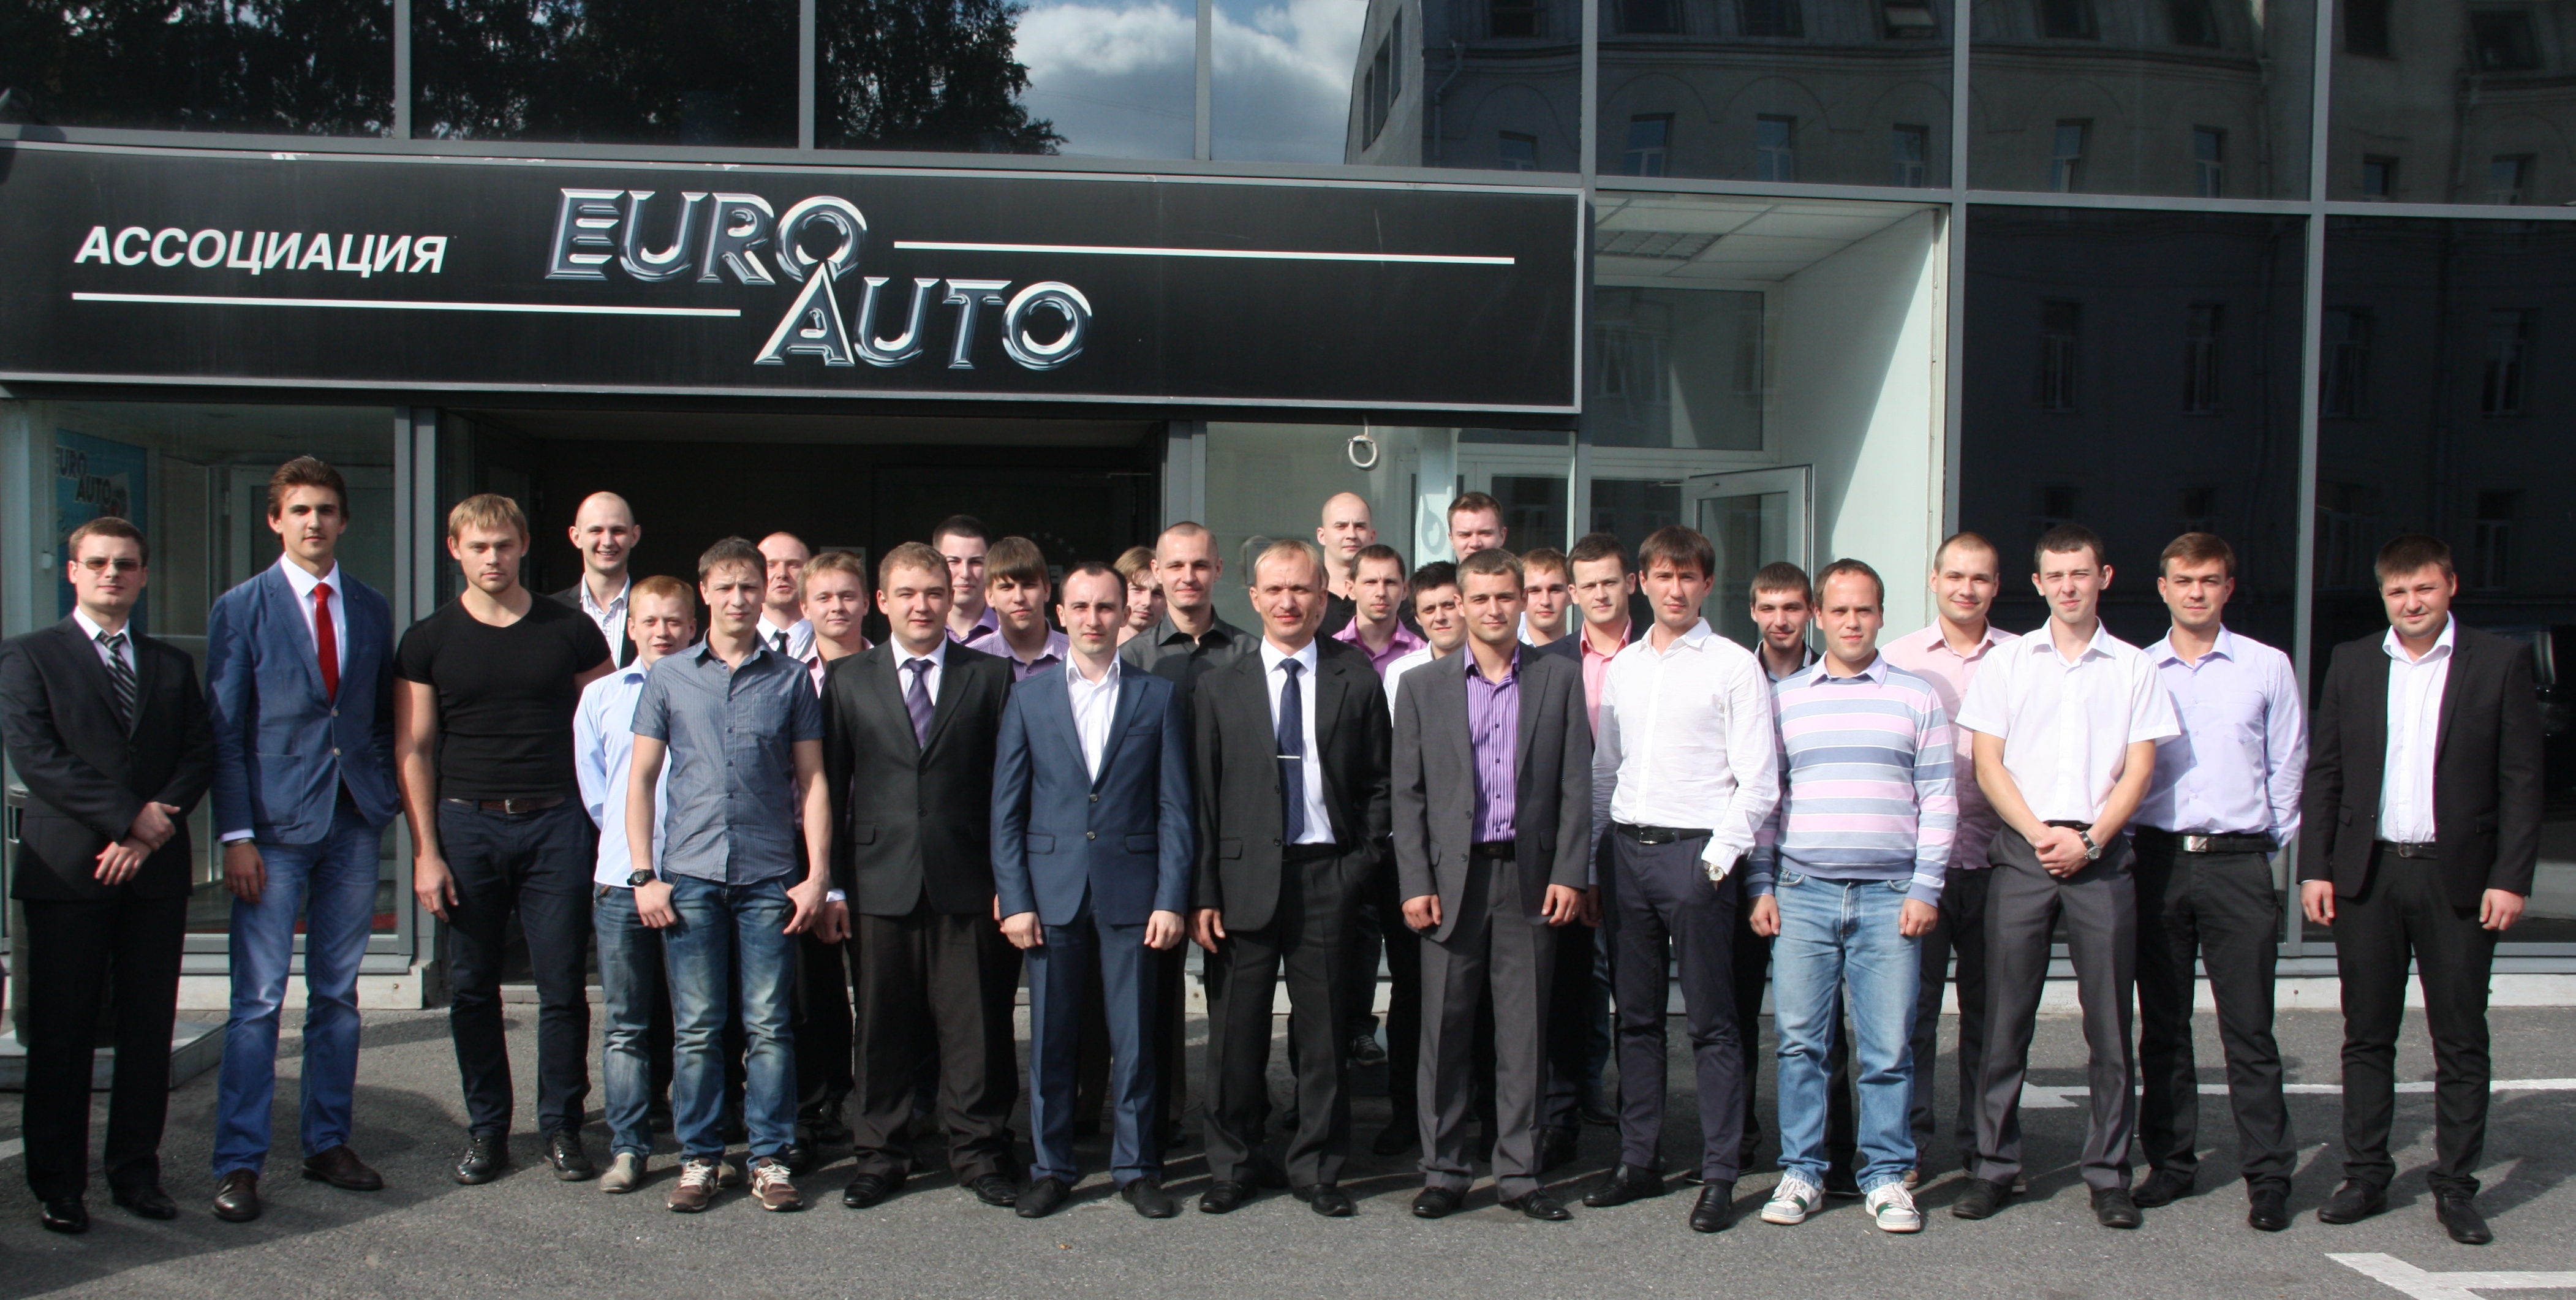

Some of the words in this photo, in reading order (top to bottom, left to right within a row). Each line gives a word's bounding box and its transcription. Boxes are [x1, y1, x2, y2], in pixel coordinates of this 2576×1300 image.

[74, 225, 447, 278] АССОЦИАЦИЯ
[545, 187, 867, 285] EURO
[754, 262, 1093, 371] AUTO
[74, 473, 111, 505] AUTO
